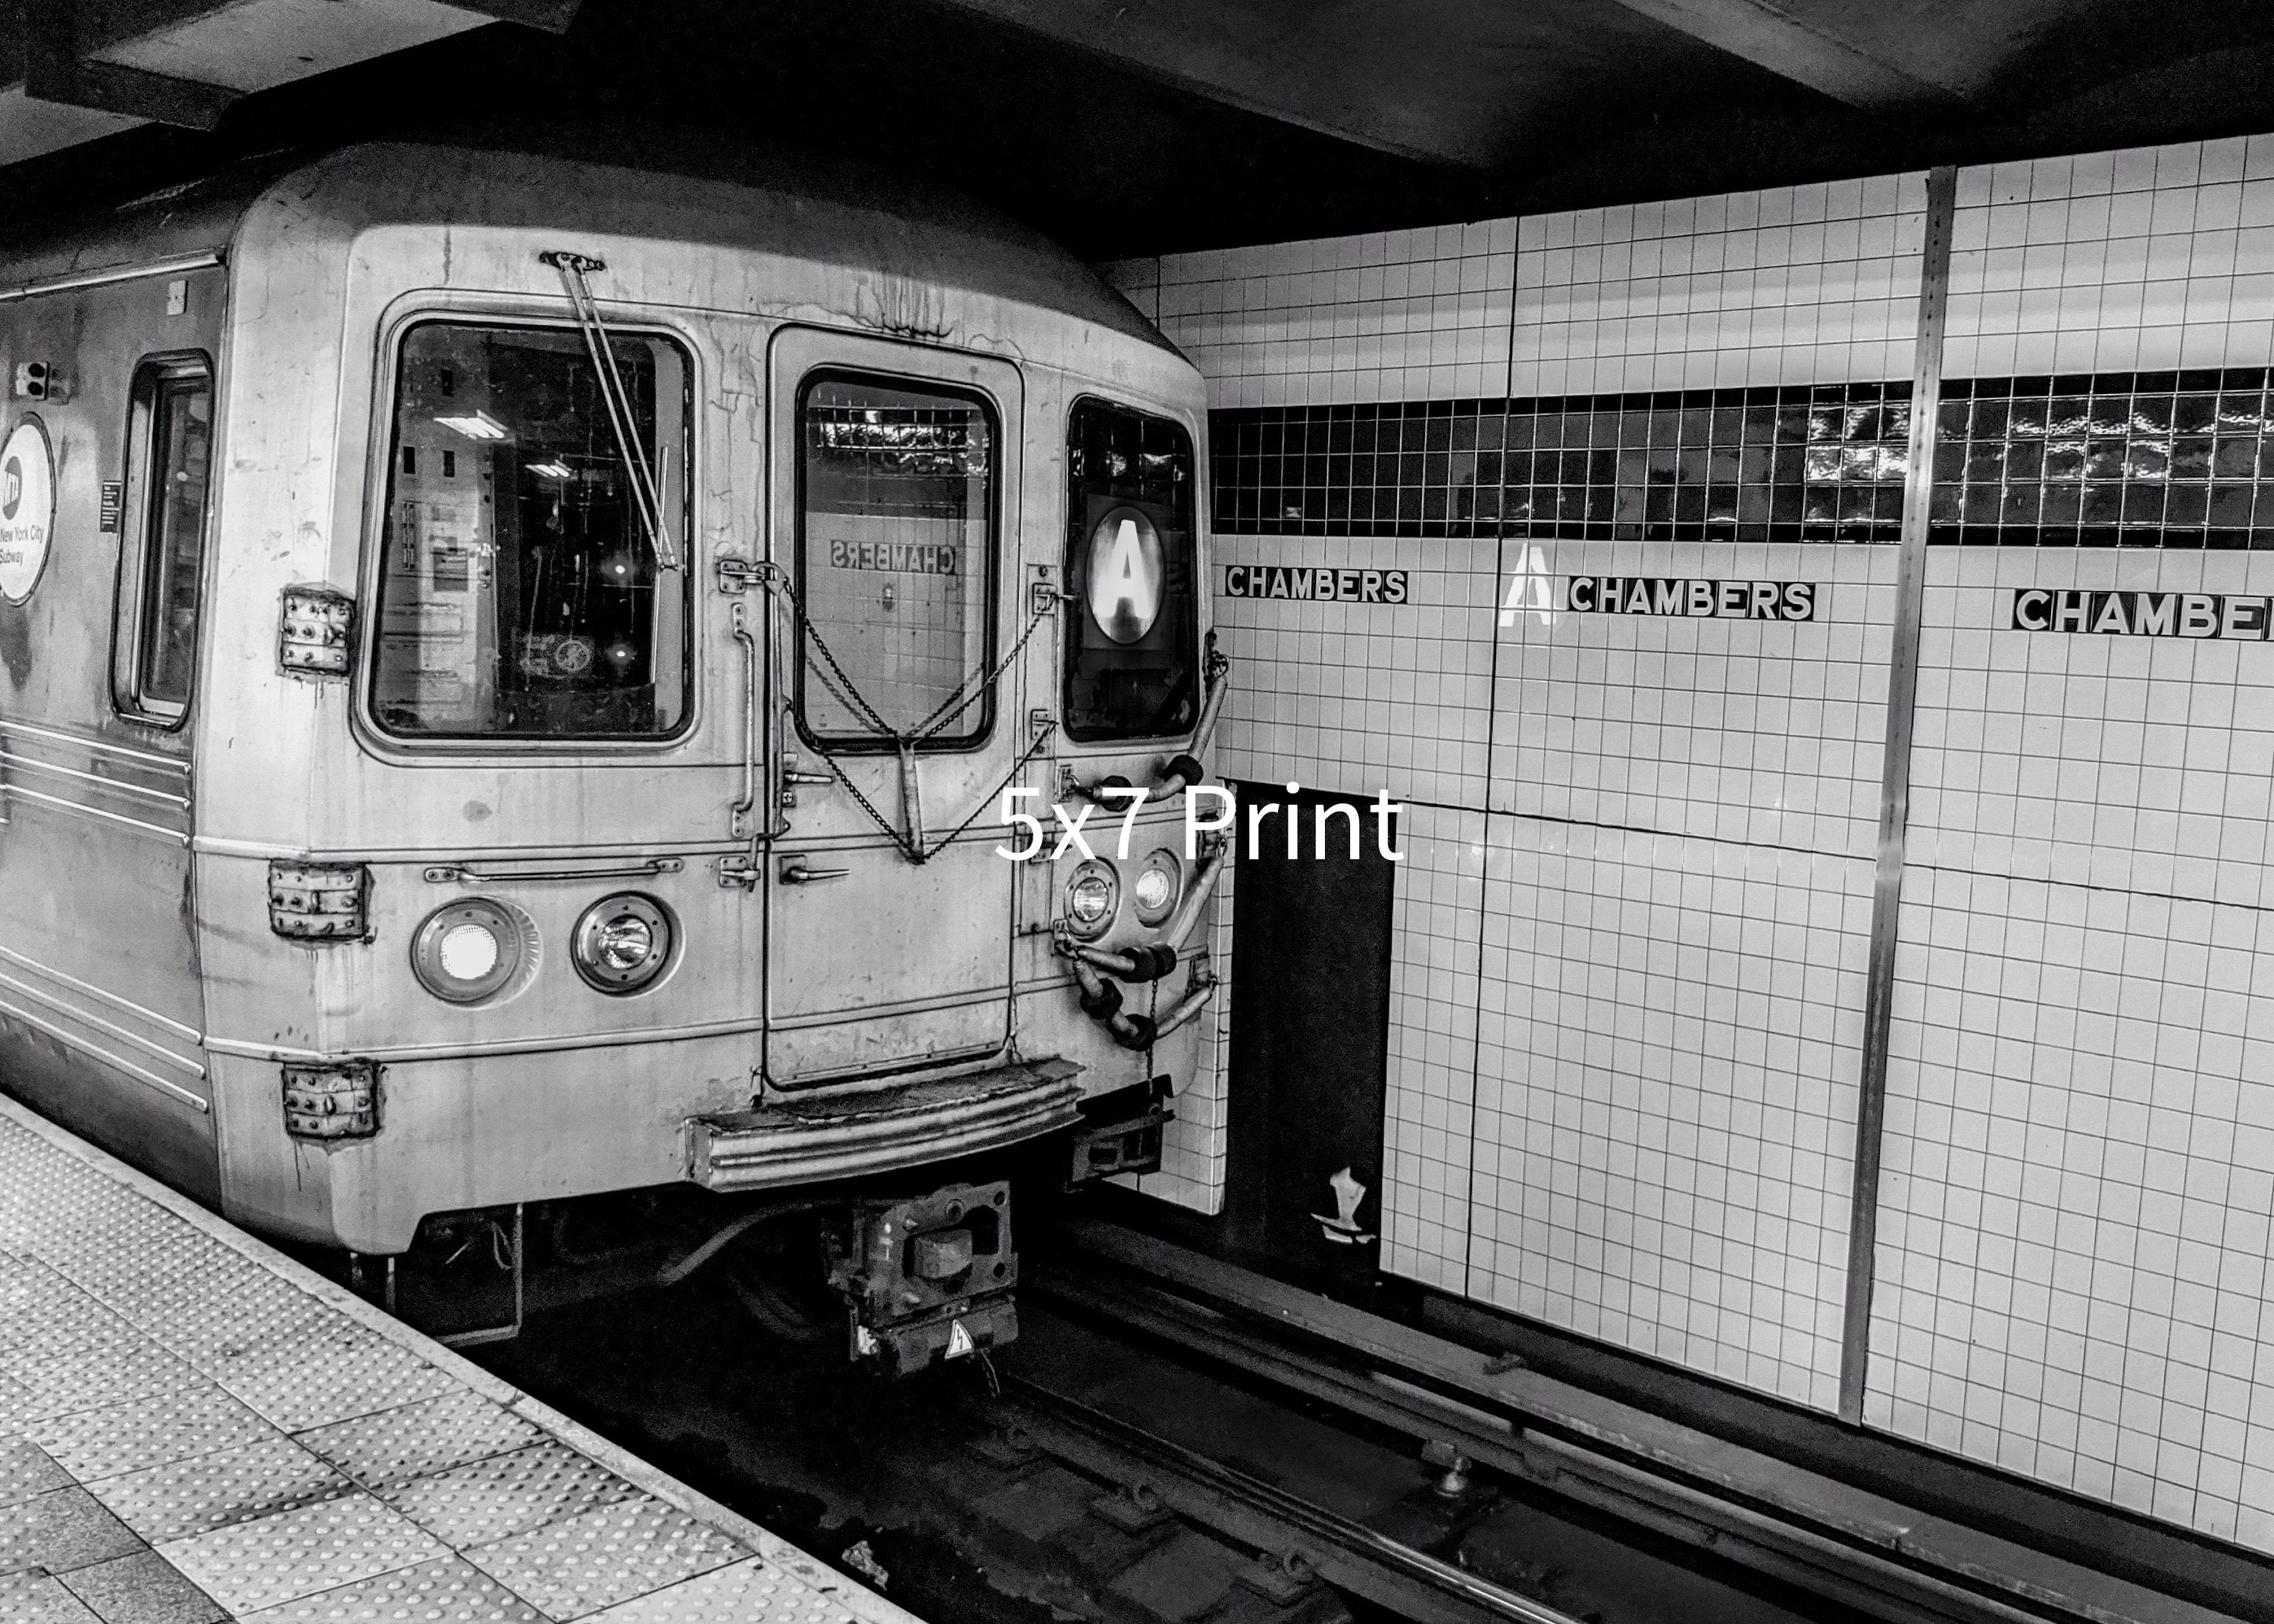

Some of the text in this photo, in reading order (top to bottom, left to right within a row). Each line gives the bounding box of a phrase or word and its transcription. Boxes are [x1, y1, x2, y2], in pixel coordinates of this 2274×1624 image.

[0, 524, 44, 544] New York City
[0, 549, 23, 567] Subway
[1093, 519, 1151, 618] A
[1226, 566, 1406, 604] CHAMBERS
[1499, 543, 1557, 627] A
[1569, 577, 1812, 621] CHAMBERS
[2016, 590, 2274, 640] CHAMBE
